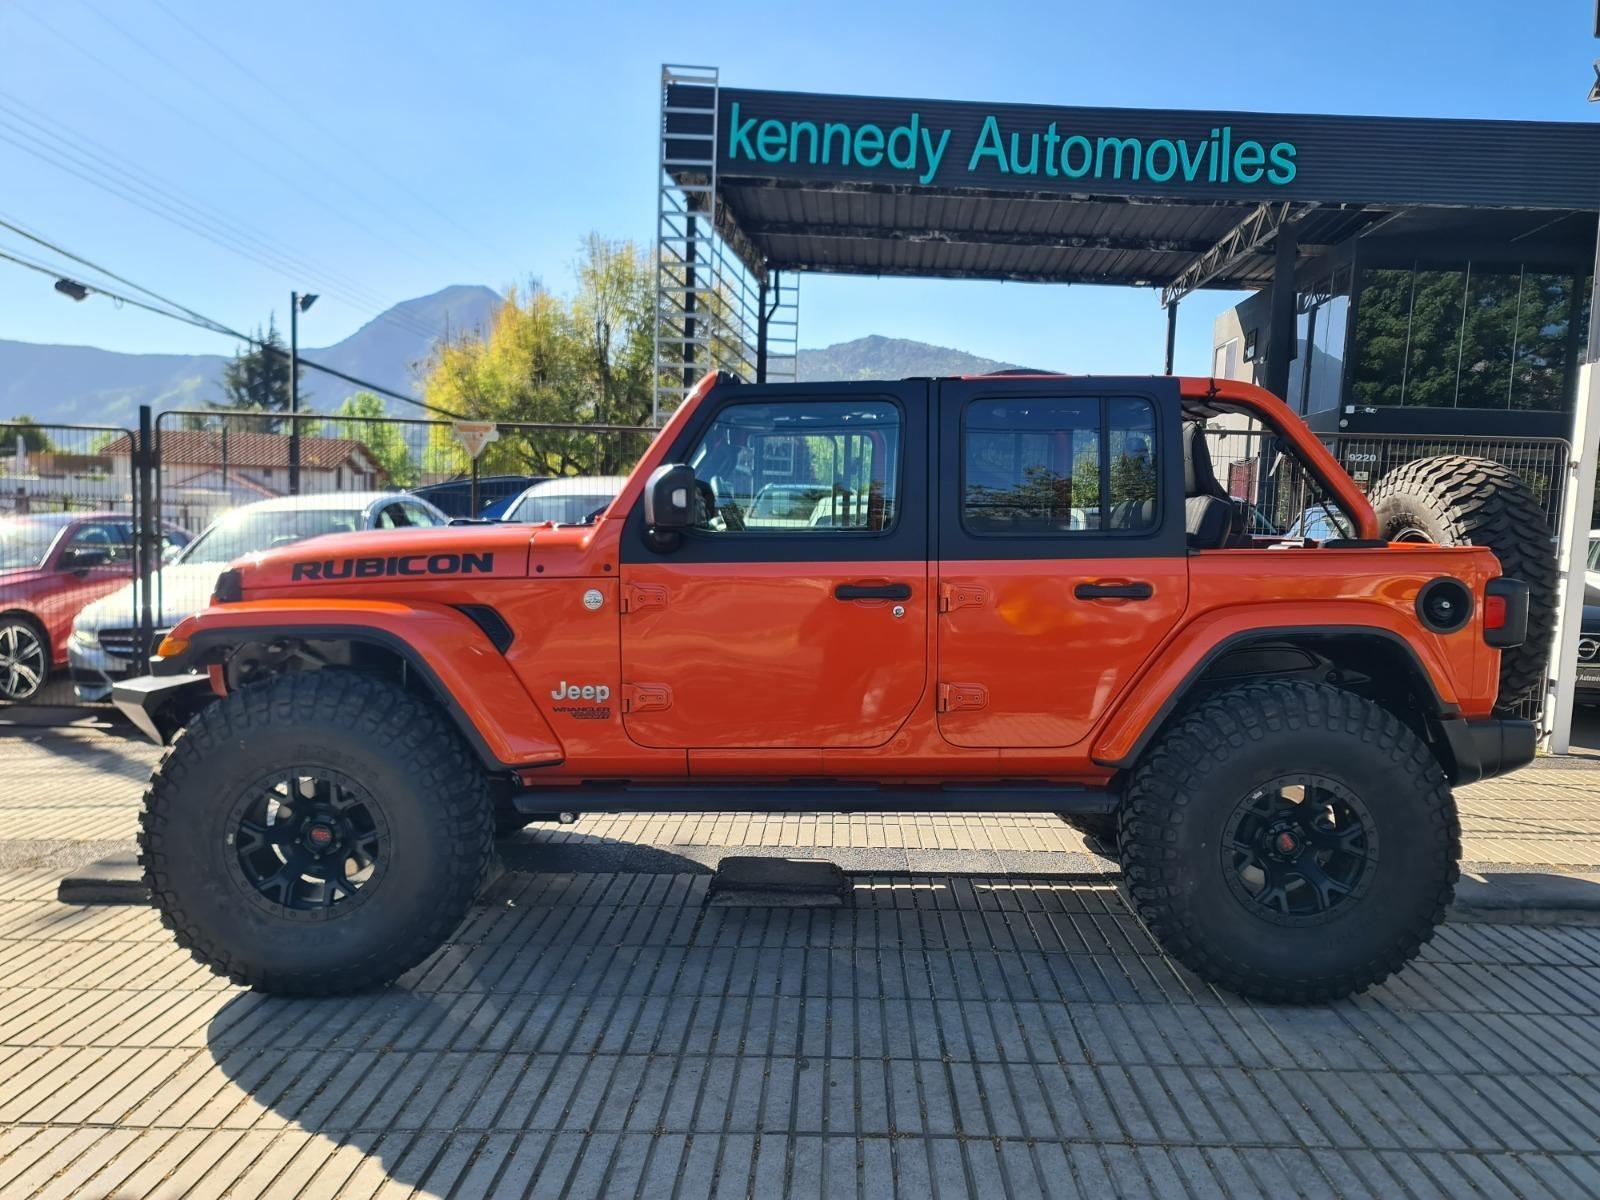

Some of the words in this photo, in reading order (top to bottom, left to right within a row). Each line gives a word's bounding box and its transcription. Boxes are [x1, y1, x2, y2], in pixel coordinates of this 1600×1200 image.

[728, 102, 951, 185] kennedy
[967, 115, 1298, 186] Automoviles
[1349, 453, 1377, 462] 9220
[291, 552, 494, 581] RUBICON
[551, 681, 610, 703] Jeep
